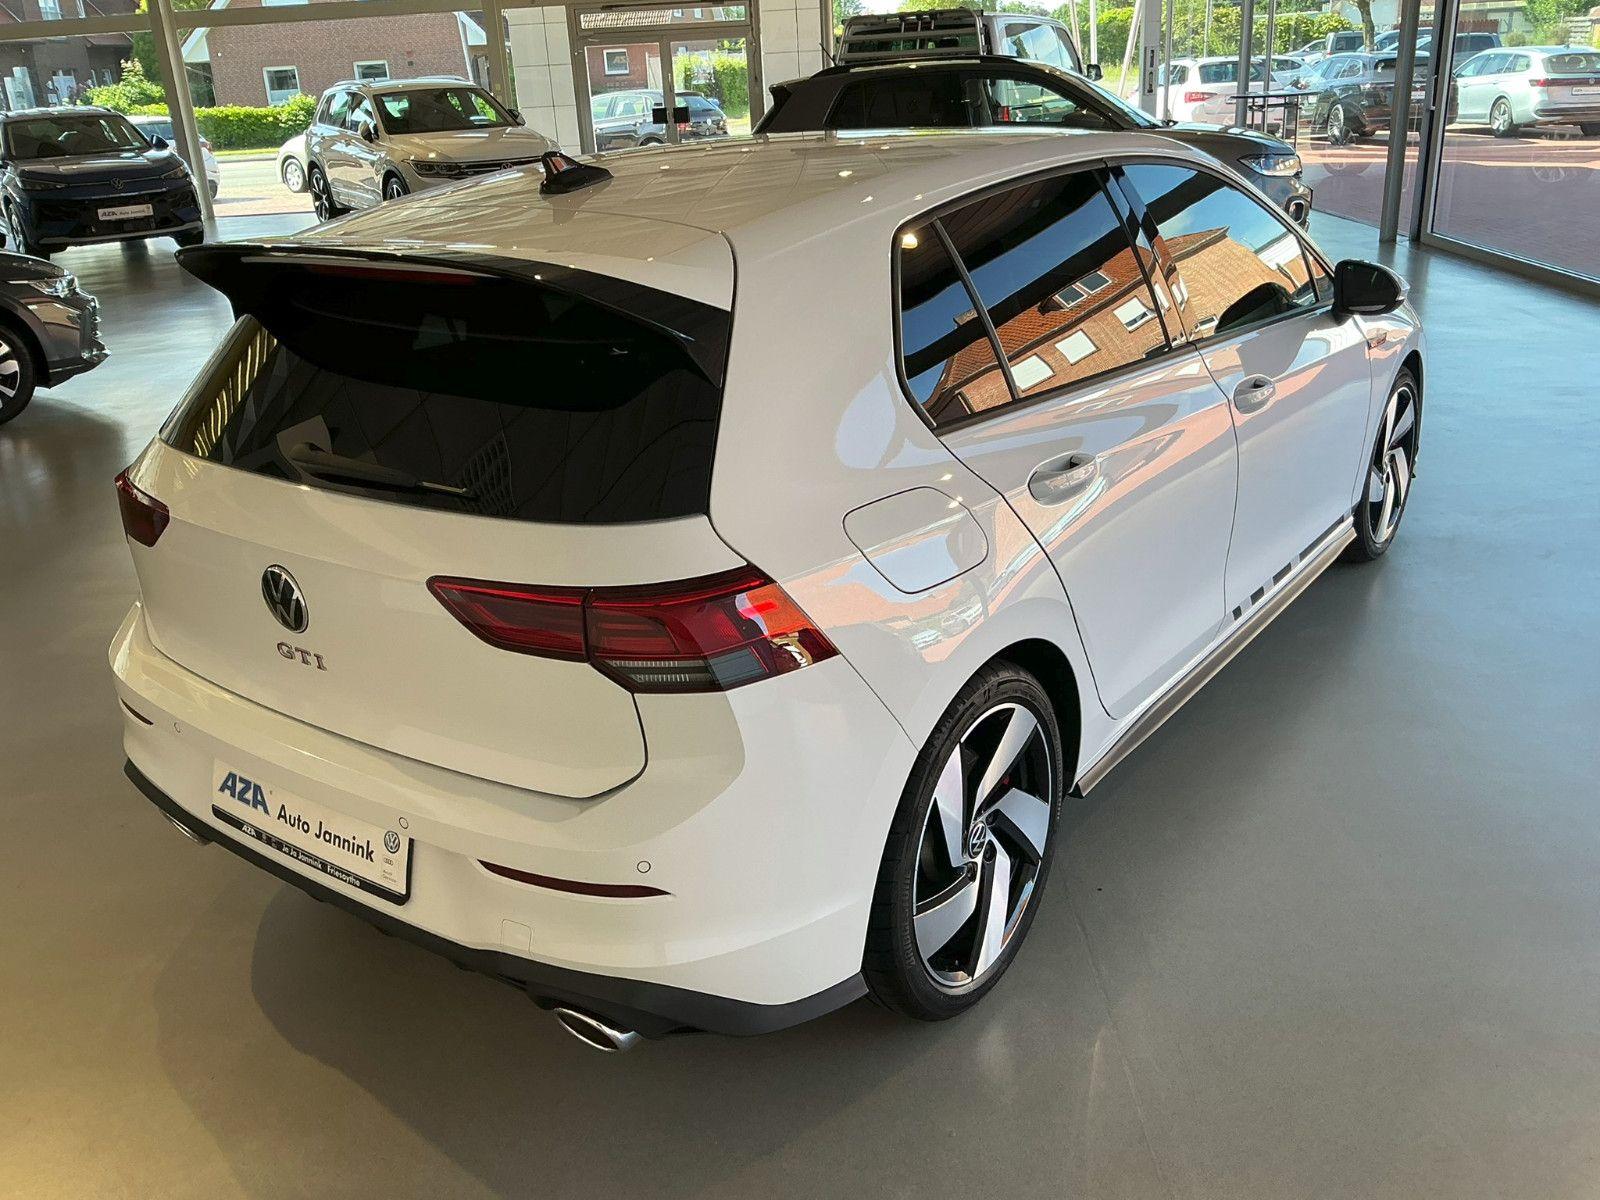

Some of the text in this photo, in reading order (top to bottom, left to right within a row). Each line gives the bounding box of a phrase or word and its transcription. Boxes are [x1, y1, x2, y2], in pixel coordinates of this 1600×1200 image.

[277, 641, 327, 671] GTI
[219, 771, 270, 816] AZA
[277, 804, 375, 863] Auto Jannink
